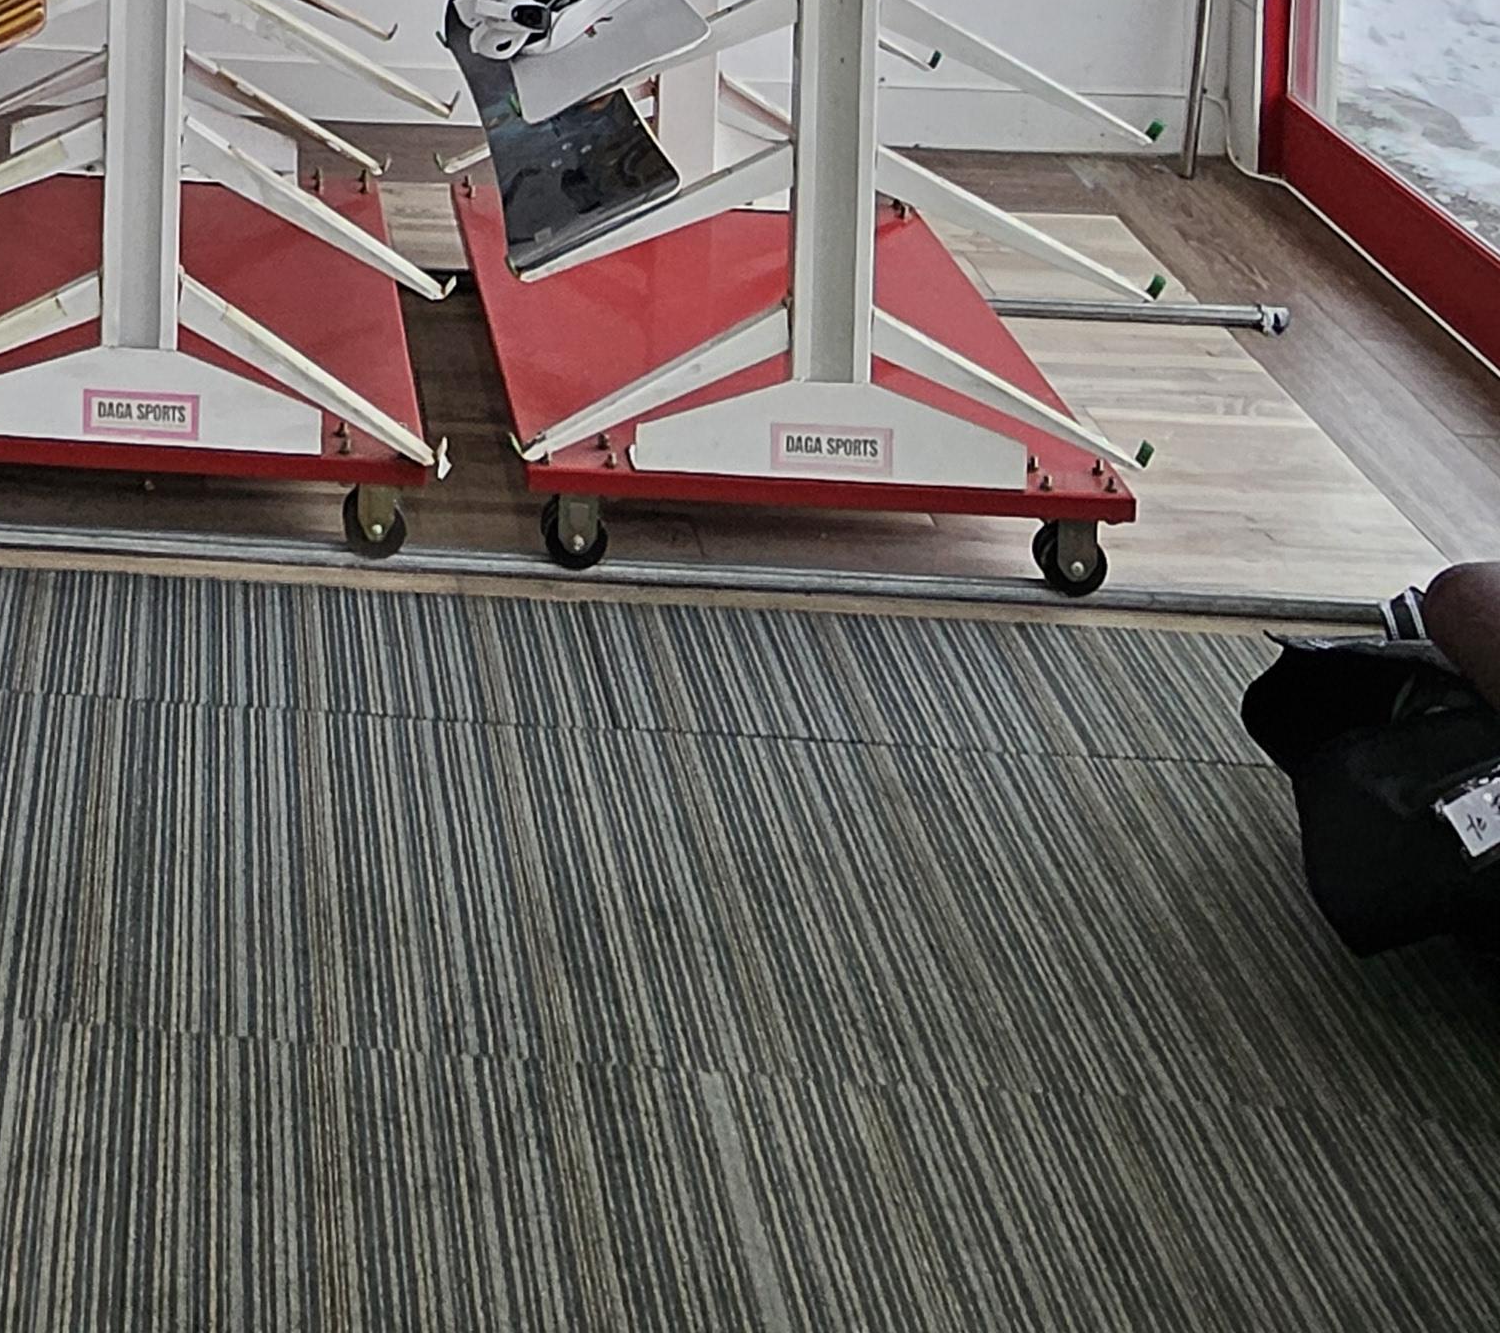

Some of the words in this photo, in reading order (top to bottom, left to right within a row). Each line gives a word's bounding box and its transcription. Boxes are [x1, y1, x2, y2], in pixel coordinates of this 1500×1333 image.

[97, 401, 133, 419] DAGA
[136, 403, 186, 423] SPORTS
[786, 435, 823, 454] DAGA
[826, 437, 878, 457] SPORTS
